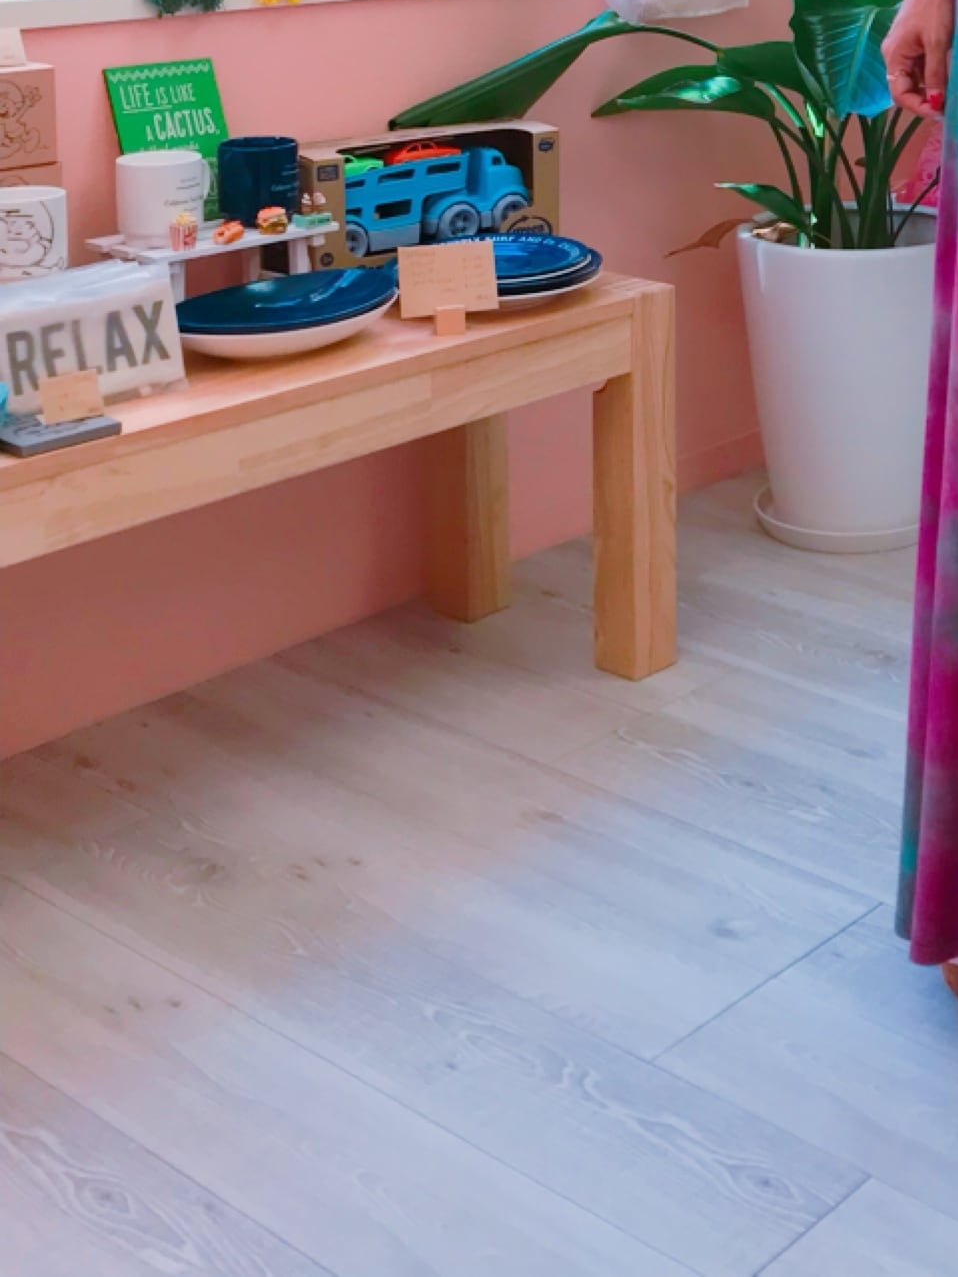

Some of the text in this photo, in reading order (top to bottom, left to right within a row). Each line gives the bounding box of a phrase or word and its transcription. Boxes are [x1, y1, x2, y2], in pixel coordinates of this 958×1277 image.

[120, 83, 196, 110] LIFE IS LIKE
[6, 300, 171, 396] RELAX
